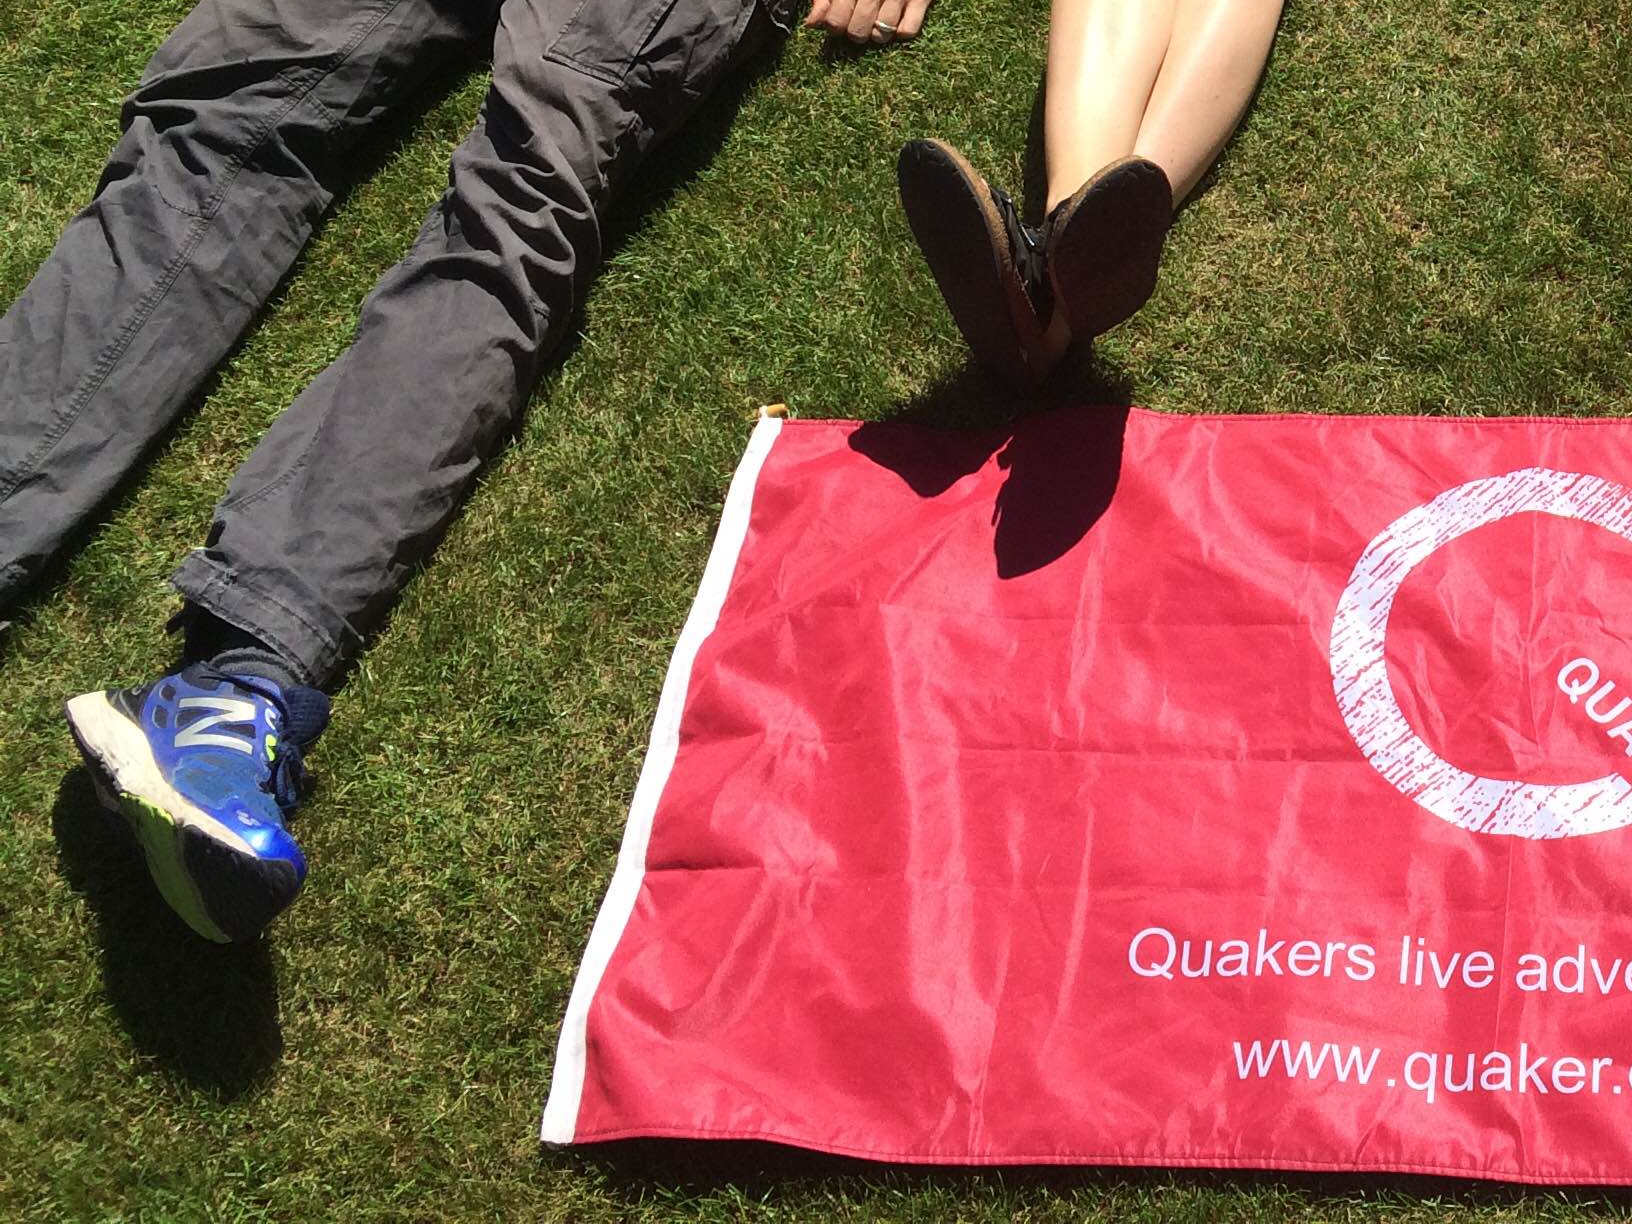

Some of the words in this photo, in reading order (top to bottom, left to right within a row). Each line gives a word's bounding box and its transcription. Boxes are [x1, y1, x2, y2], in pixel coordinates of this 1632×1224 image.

[173, 696, 257, 755] N
[1128, 927, 1376, 982] Quakers
[1399, 935, 1495, 989] live
